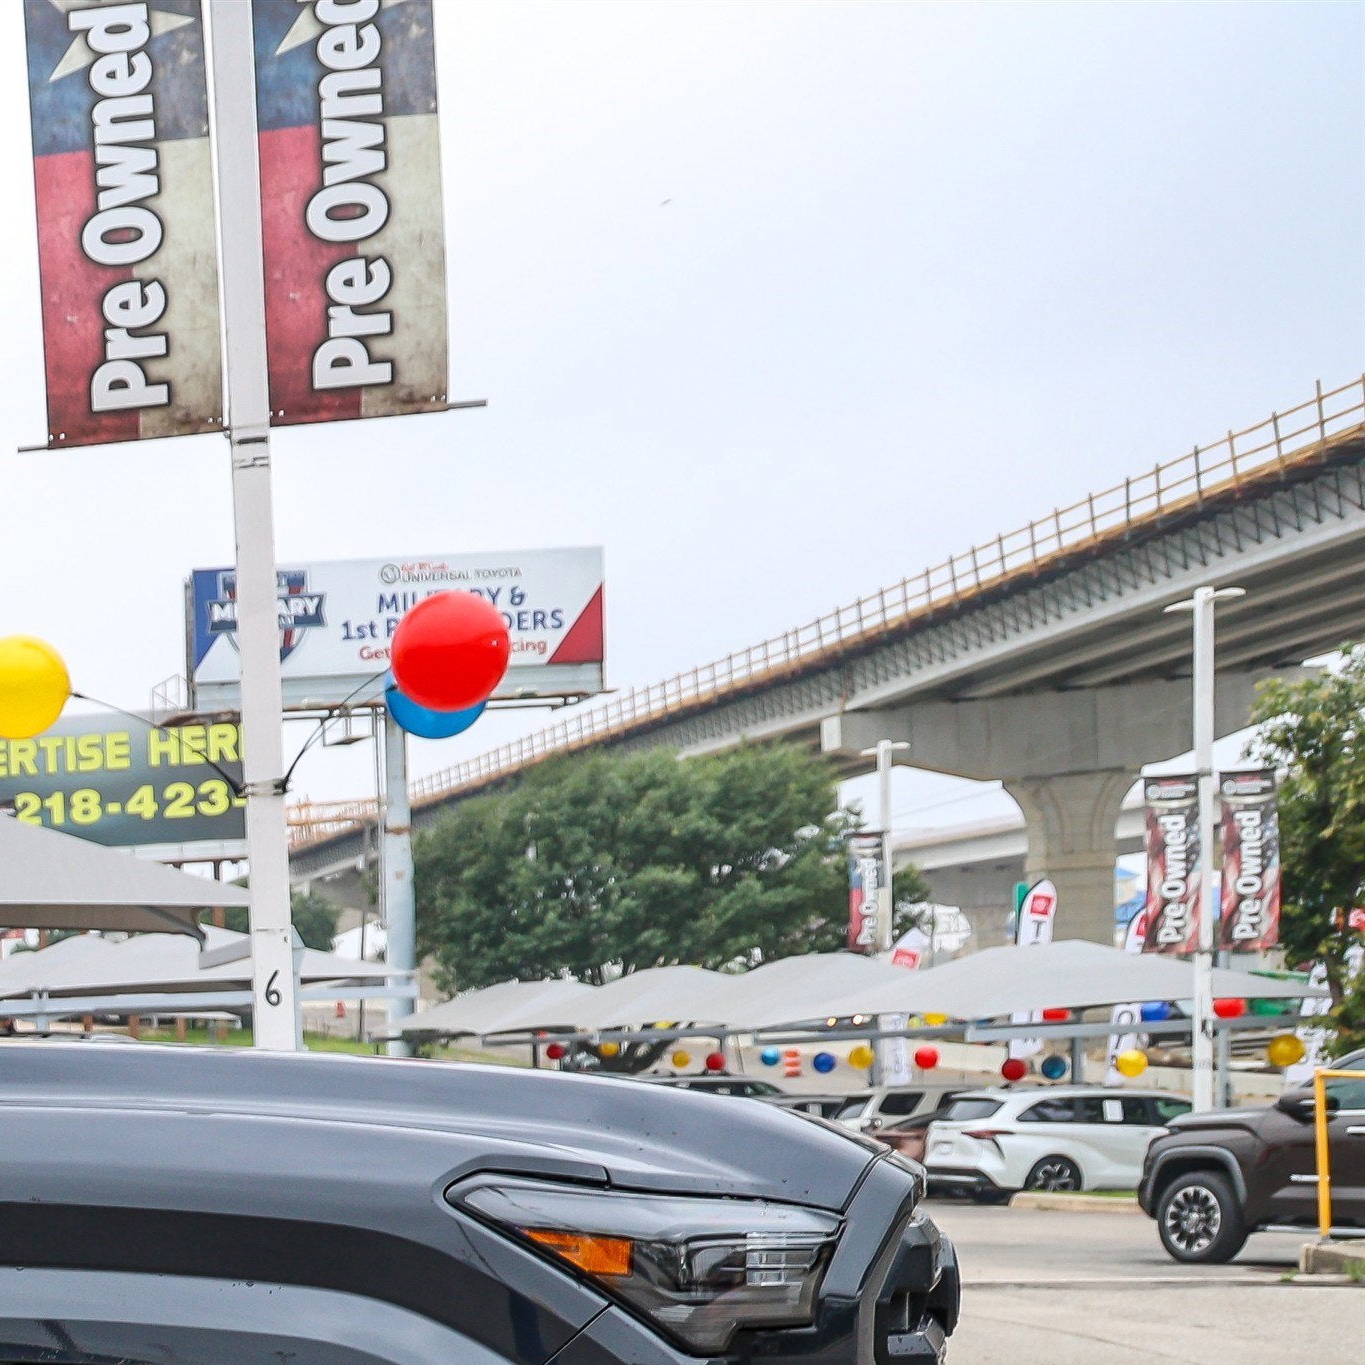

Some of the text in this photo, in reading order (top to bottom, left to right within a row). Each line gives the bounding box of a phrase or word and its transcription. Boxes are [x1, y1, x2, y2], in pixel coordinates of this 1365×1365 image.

[69, 2, 170, 412] Pre Owned
[312, 257, 393, 390] Pre
[473, 566, 523, 578] TOYOTA
[510, 585, 525, 606] &
[342, 620, 378, 640] 1st
[148, 722, 245, 768] HER
[1157, 814, 1188, 899] Owned
[1232, 810, 1263, 895] Owned
[1155, 902, 1186, 943] Pre
[1231, 898, 1261, 939] Pre
[265, 969, 280, 1007] 6
